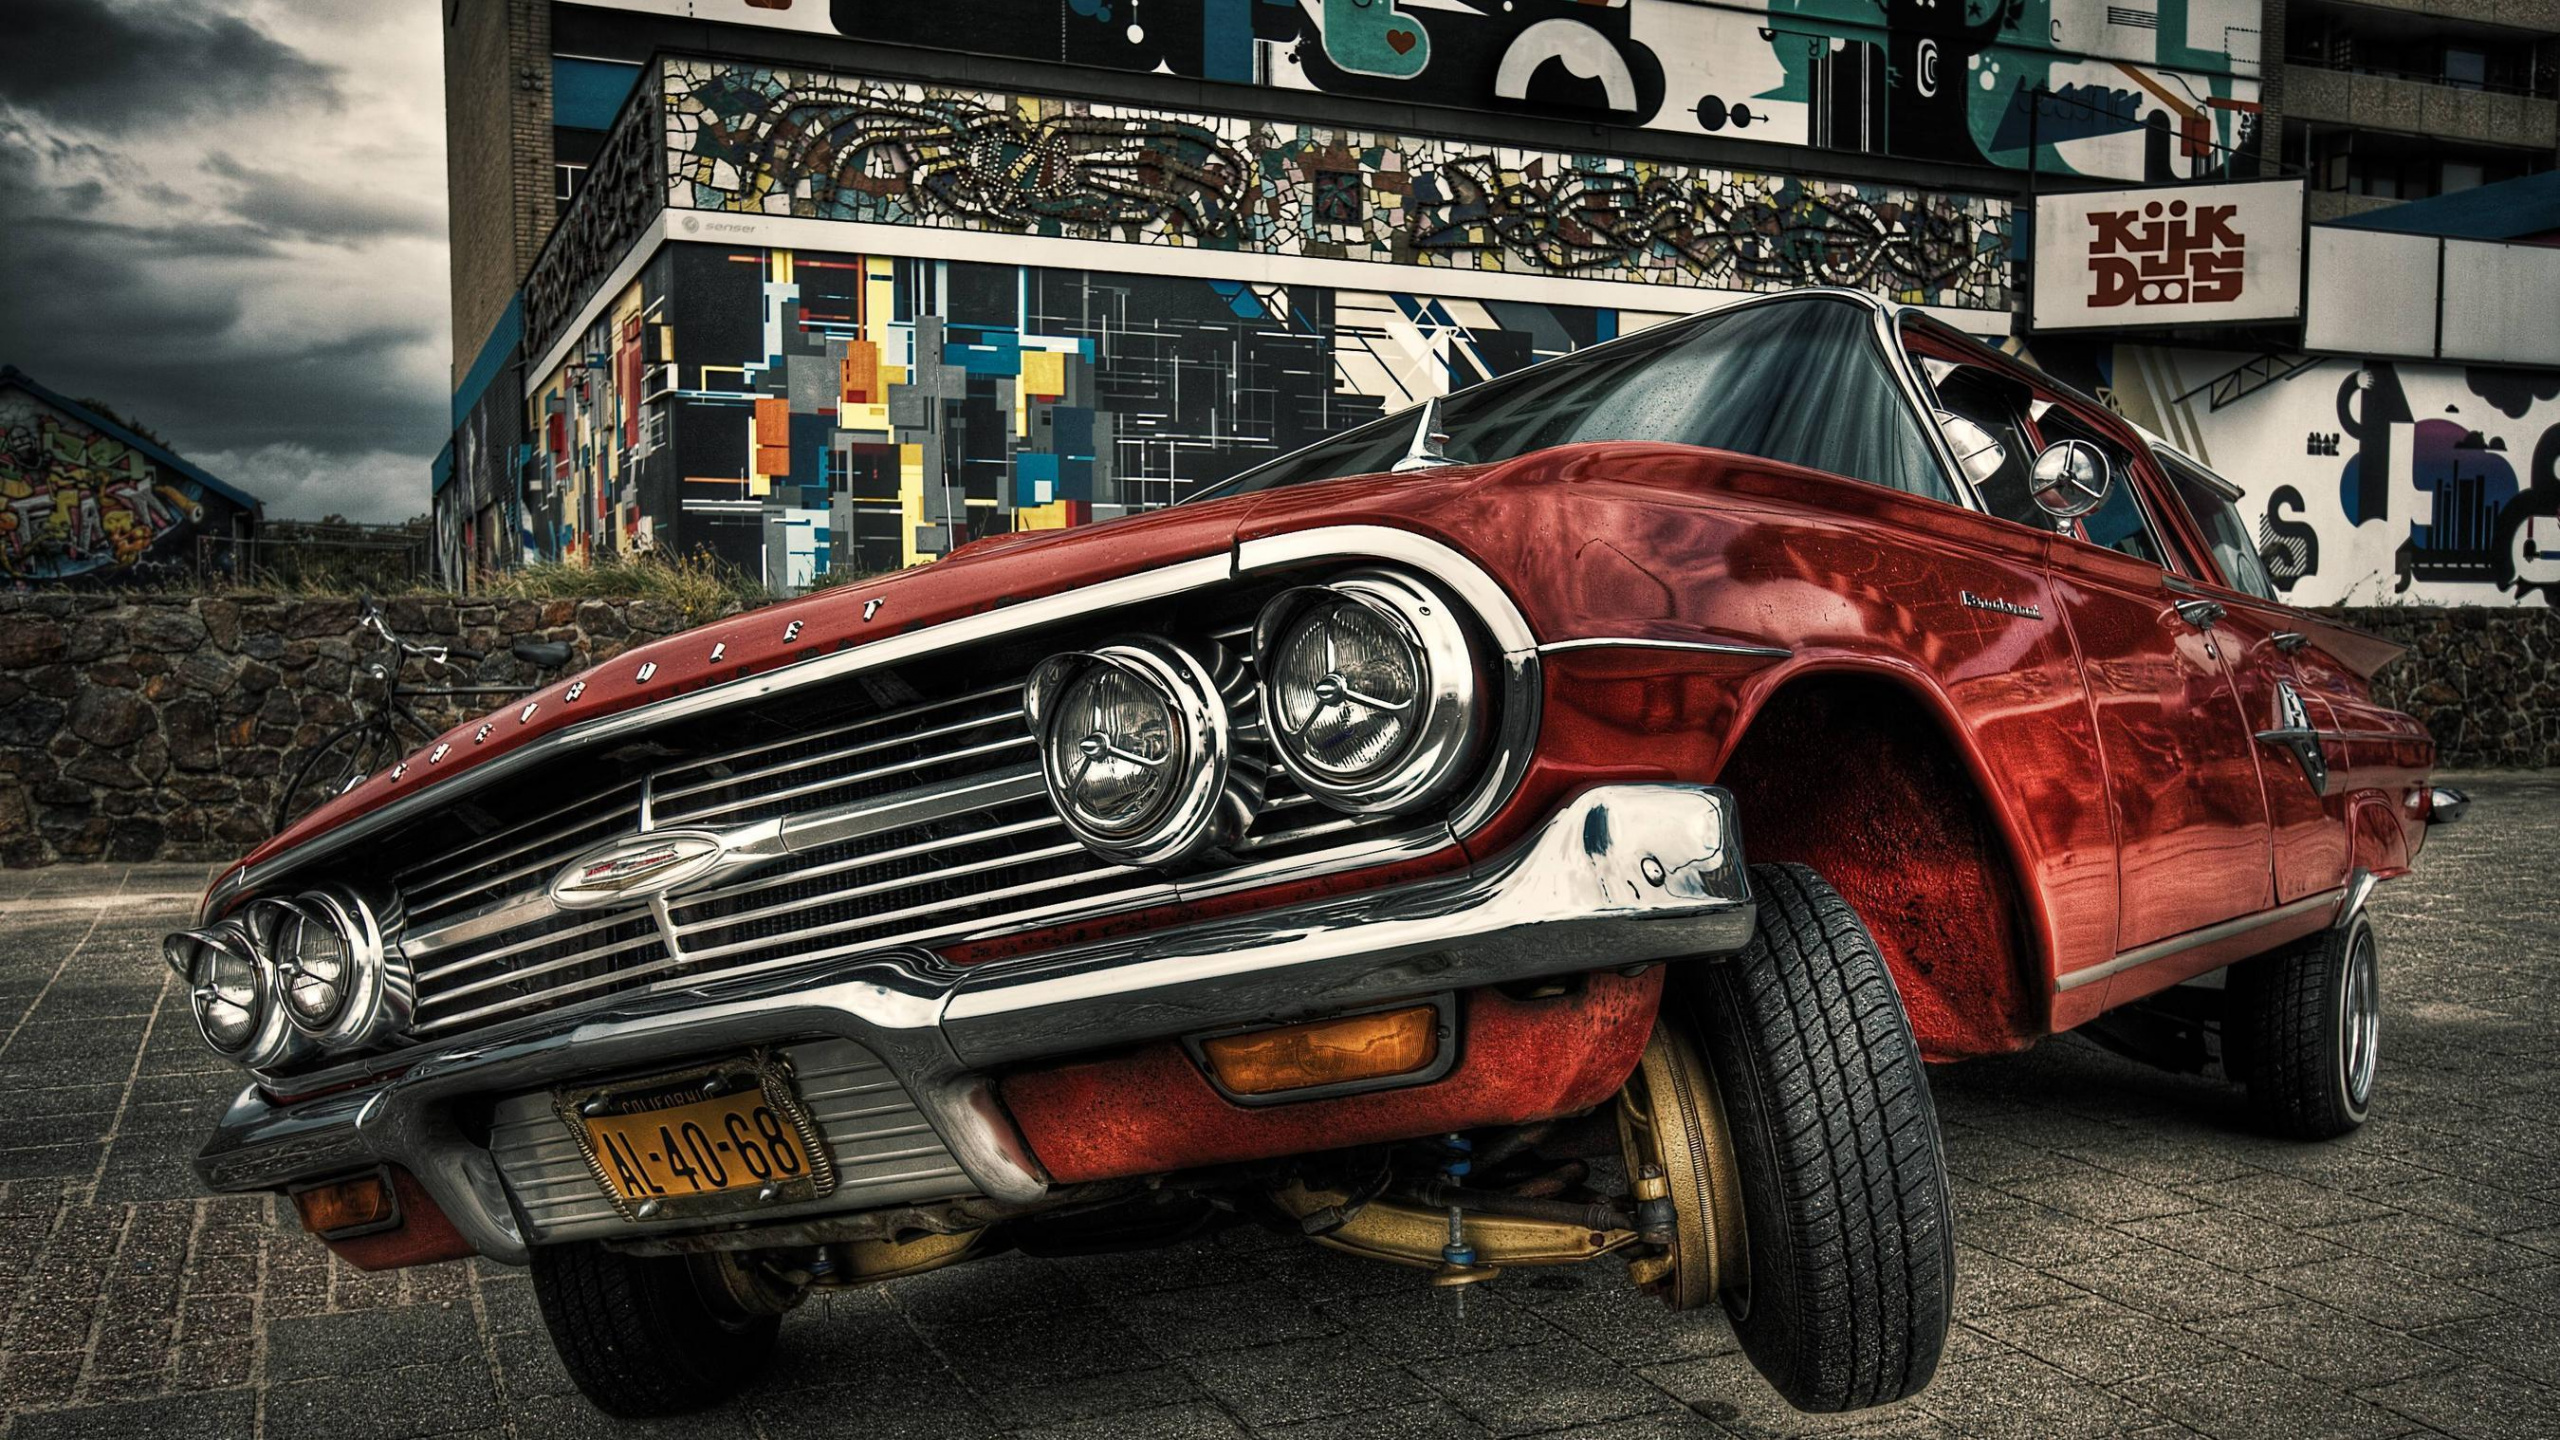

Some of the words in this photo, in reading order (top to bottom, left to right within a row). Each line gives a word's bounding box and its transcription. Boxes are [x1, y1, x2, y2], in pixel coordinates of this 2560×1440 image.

[704, 221, 757, 234] senser
[390, 595, 886, 783] CHEVROLET
[601, 1105, 801, 1197] AL-40-68
